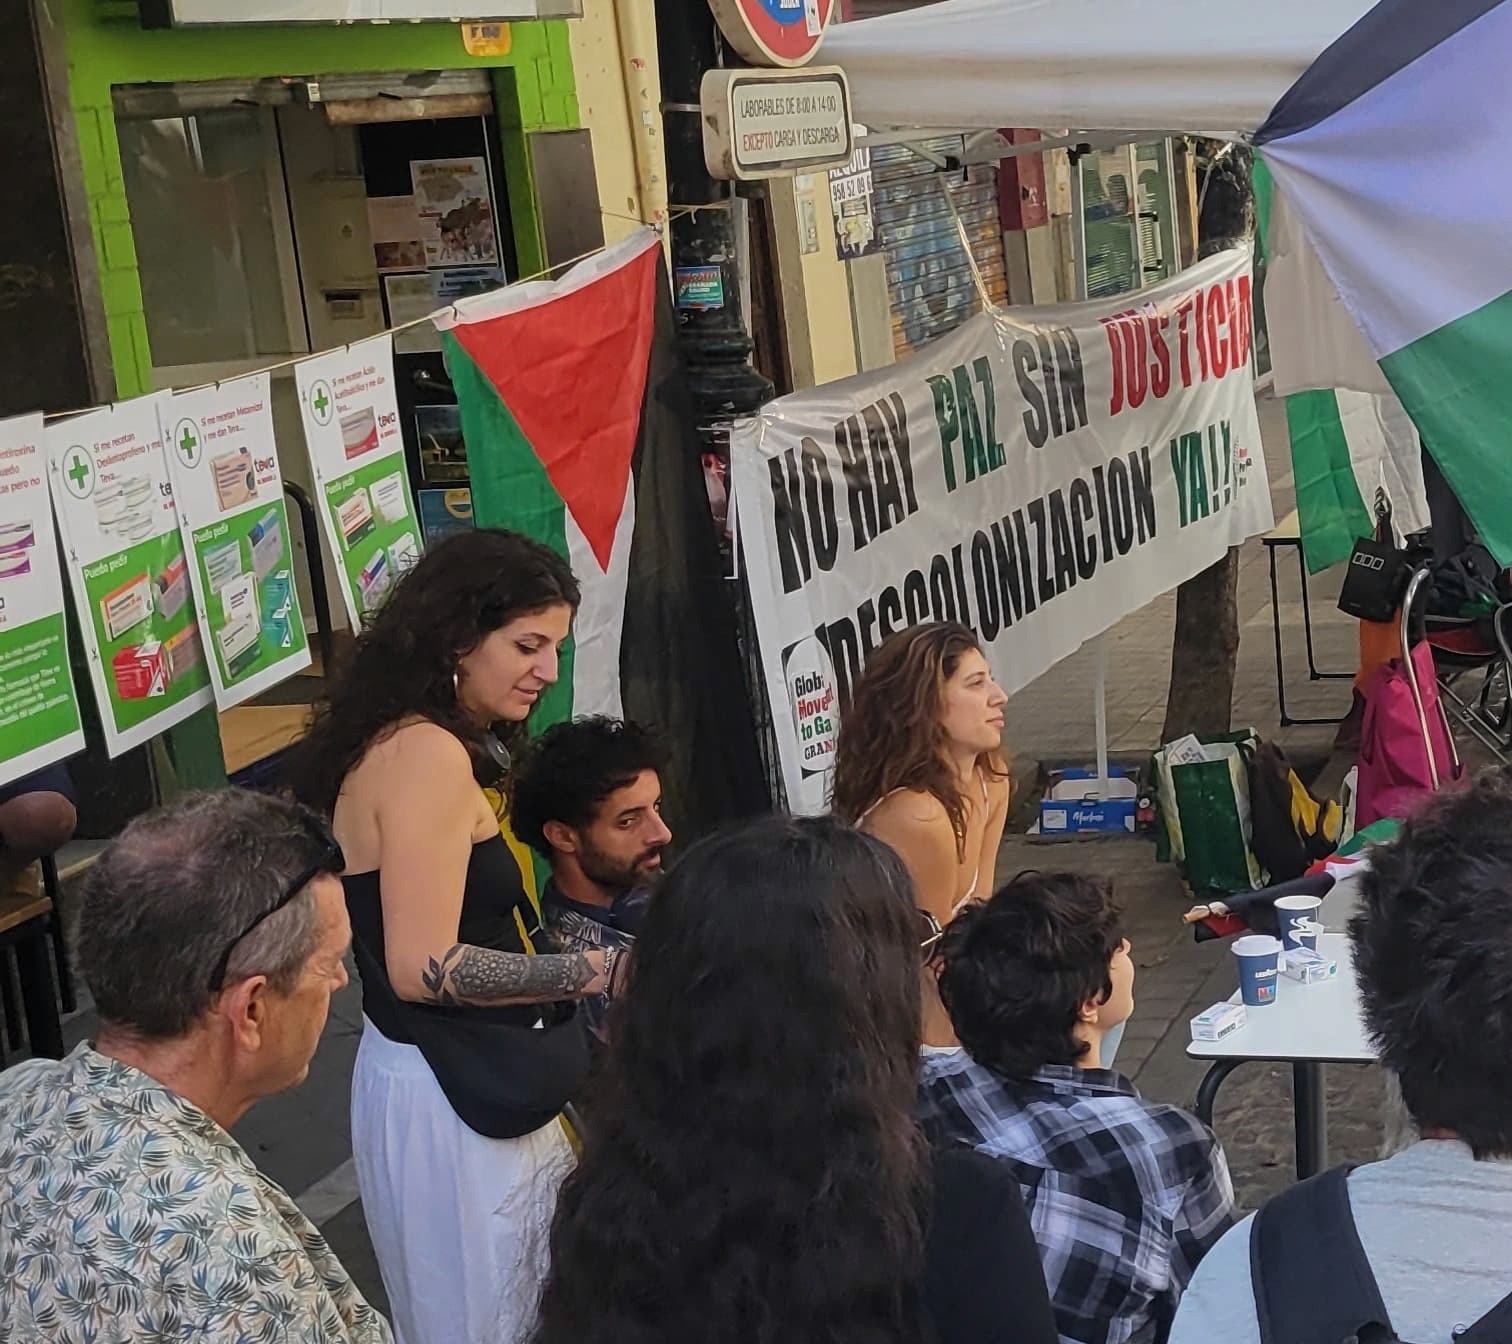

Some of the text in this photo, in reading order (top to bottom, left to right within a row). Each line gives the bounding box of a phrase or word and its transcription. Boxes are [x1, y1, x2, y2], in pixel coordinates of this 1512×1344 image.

[741, 99, 784, 118] LABORABLES
[786, 97, 796, 114] DE
[811, 96, 816, 113] A
[743, 125, 840, 152] EXCEPTO CARGA Y DESCARGA
[378, 412, 396, 427] teva
[111, 433, 135, 447] recetan
[767, 275, 1250, 594] NO HAY PAZ SIN JUSTICIA
[254, 456, 275, 473] teva
[160, 481, 172, 496] te
[84, 553, 128, 580] Puedo pedir
[794, 671, 825, 698] Glob
[801, 715, 833, 741] to Ga
[804, 738, 833, 761] GRAN
